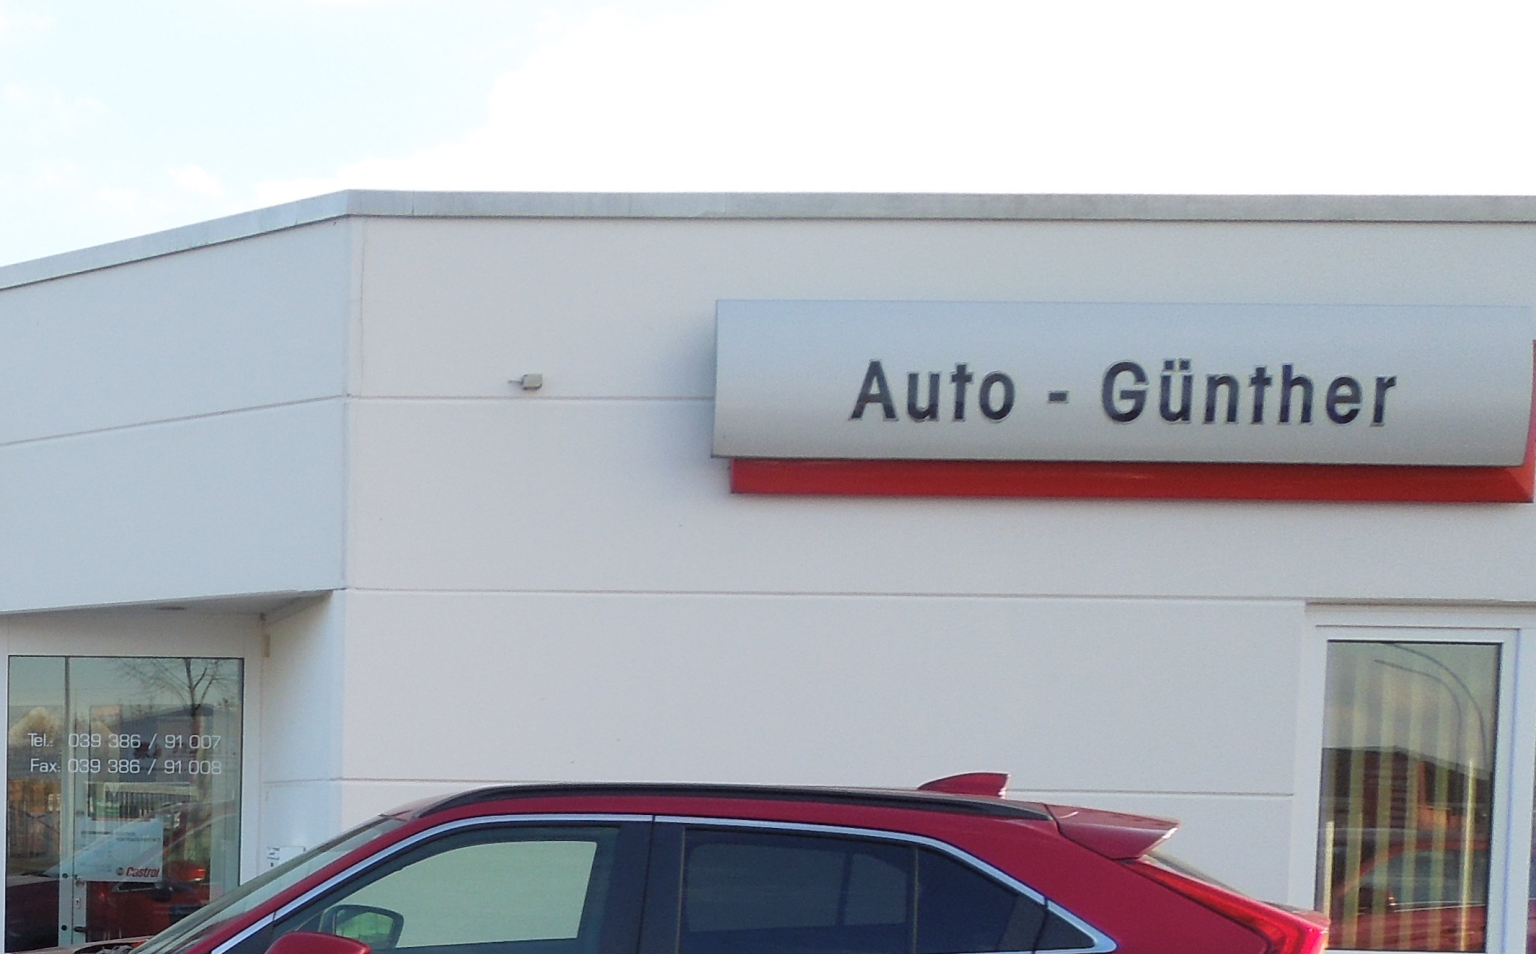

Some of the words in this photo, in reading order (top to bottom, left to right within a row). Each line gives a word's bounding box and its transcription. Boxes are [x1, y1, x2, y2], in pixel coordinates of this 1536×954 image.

[848, 358, 1017, 423] Auto
[1046, 390, 1071, 405] -
[1101, 359, 1399, 428] Günther
[67, 733, 102, 748] 039
[108, 733, 141, 749] 386
[164, 734, 183, 749] 91
[188, 734, 222, 750] 007
[30, 758, 61, 773] Fax:
[67, 758, 101, 774] 039
[107, 758, 141, 774] 386
[163, 759, 182, 775] 91
[188, 760, 223, 775] 008
[125, 866, 160, 878] Castrol
